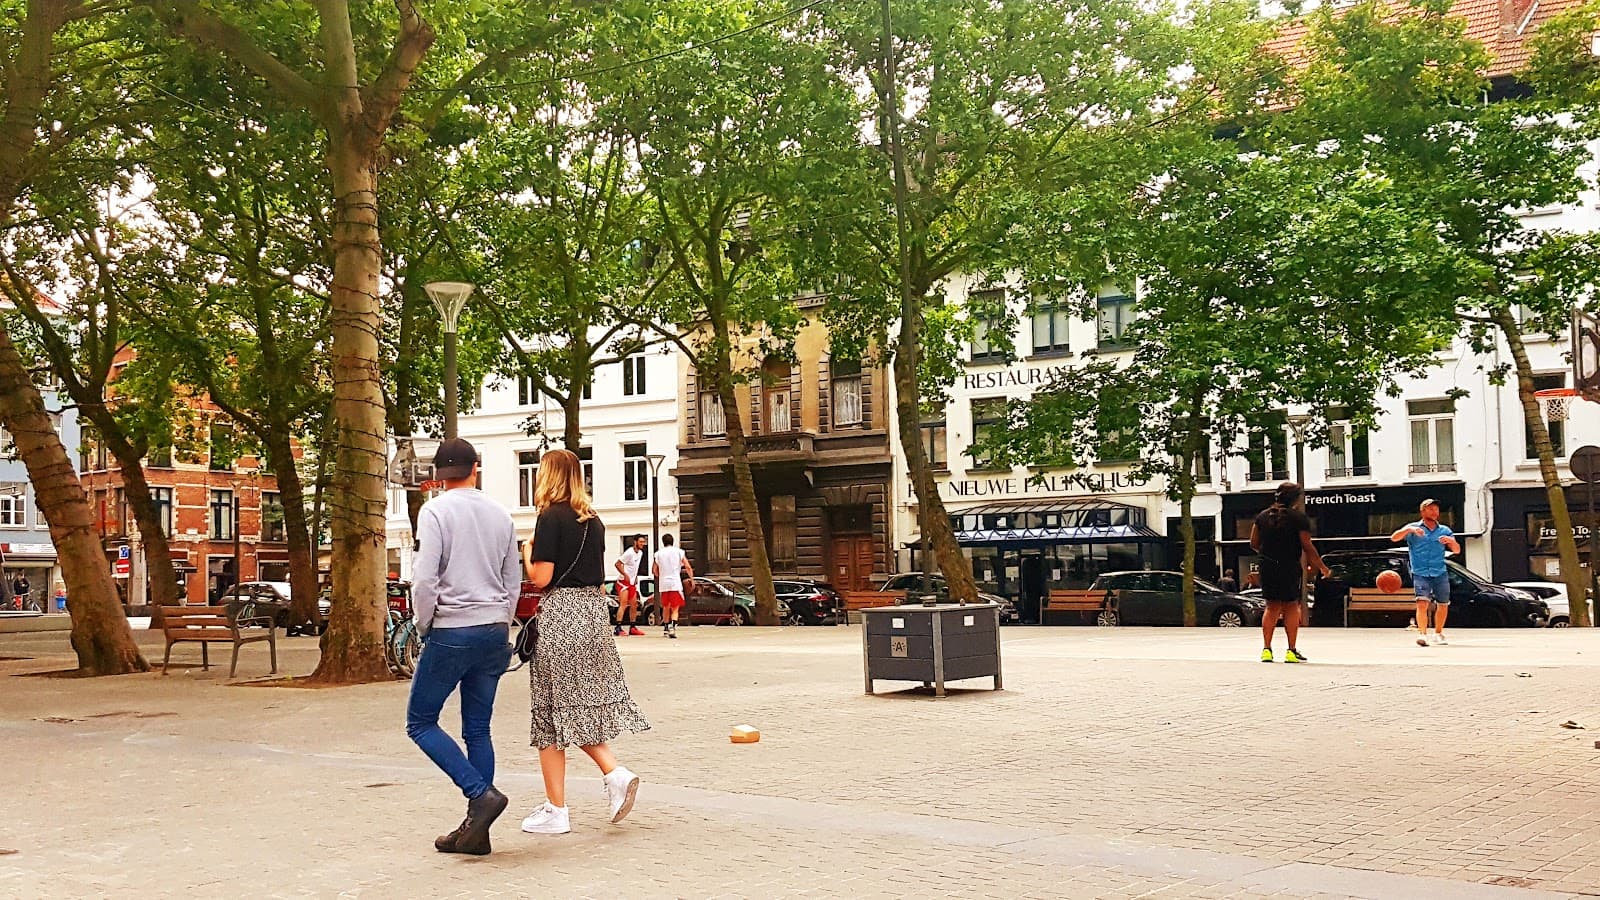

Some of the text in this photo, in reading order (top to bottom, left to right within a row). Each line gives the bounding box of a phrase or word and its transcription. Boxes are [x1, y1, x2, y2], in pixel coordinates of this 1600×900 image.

[949, 479, 1018, 496] NIEUWE
[1304, 493, 1376, 504] French Toast
